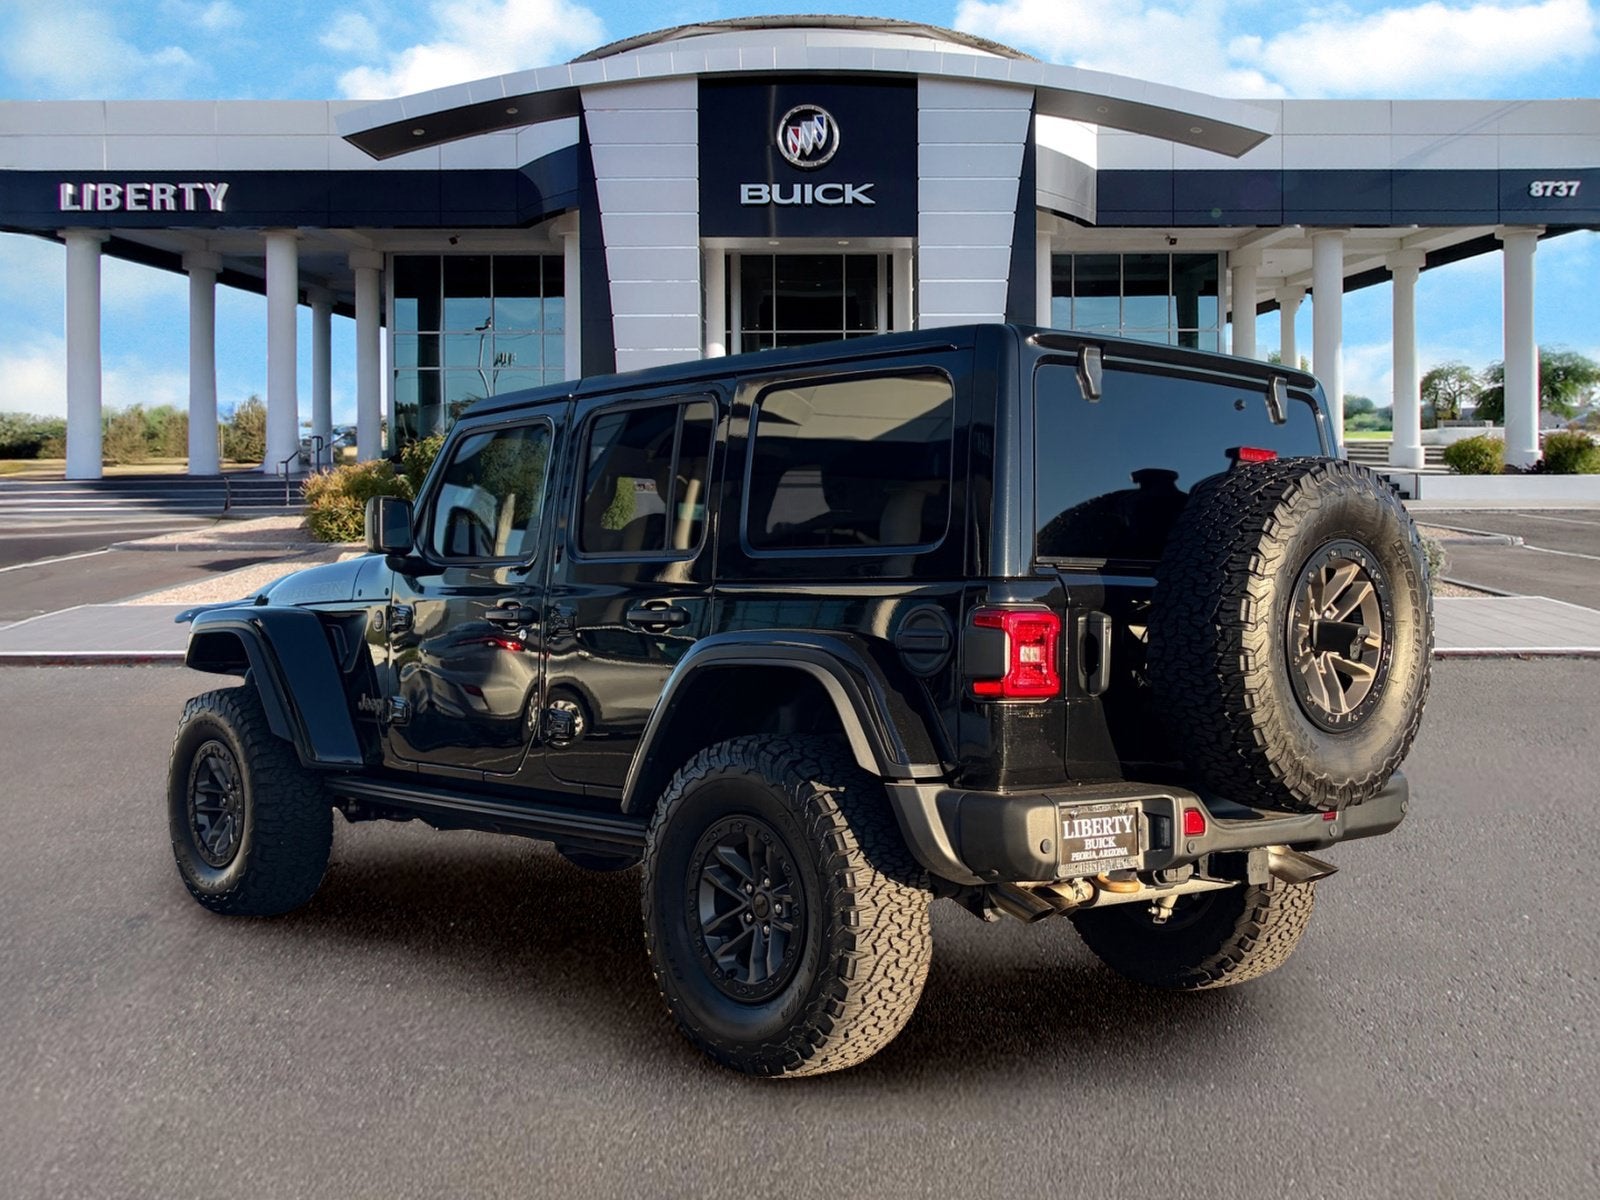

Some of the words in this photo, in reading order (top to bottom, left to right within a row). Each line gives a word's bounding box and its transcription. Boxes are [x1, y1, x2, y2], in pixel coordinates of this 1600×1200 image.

[59, 182, 230, 212] LIBERTY
[740, 183, 876, 205] BUICK
[1529, 180, 1581, 197] 8737
[358, 692, 384, 716] Jeep
[1063, 815, 1133, 839] LIBERTY
[1084, 837, 1116, 850] BUICK
[1098, 847, 1128, 859] ARIZONA
